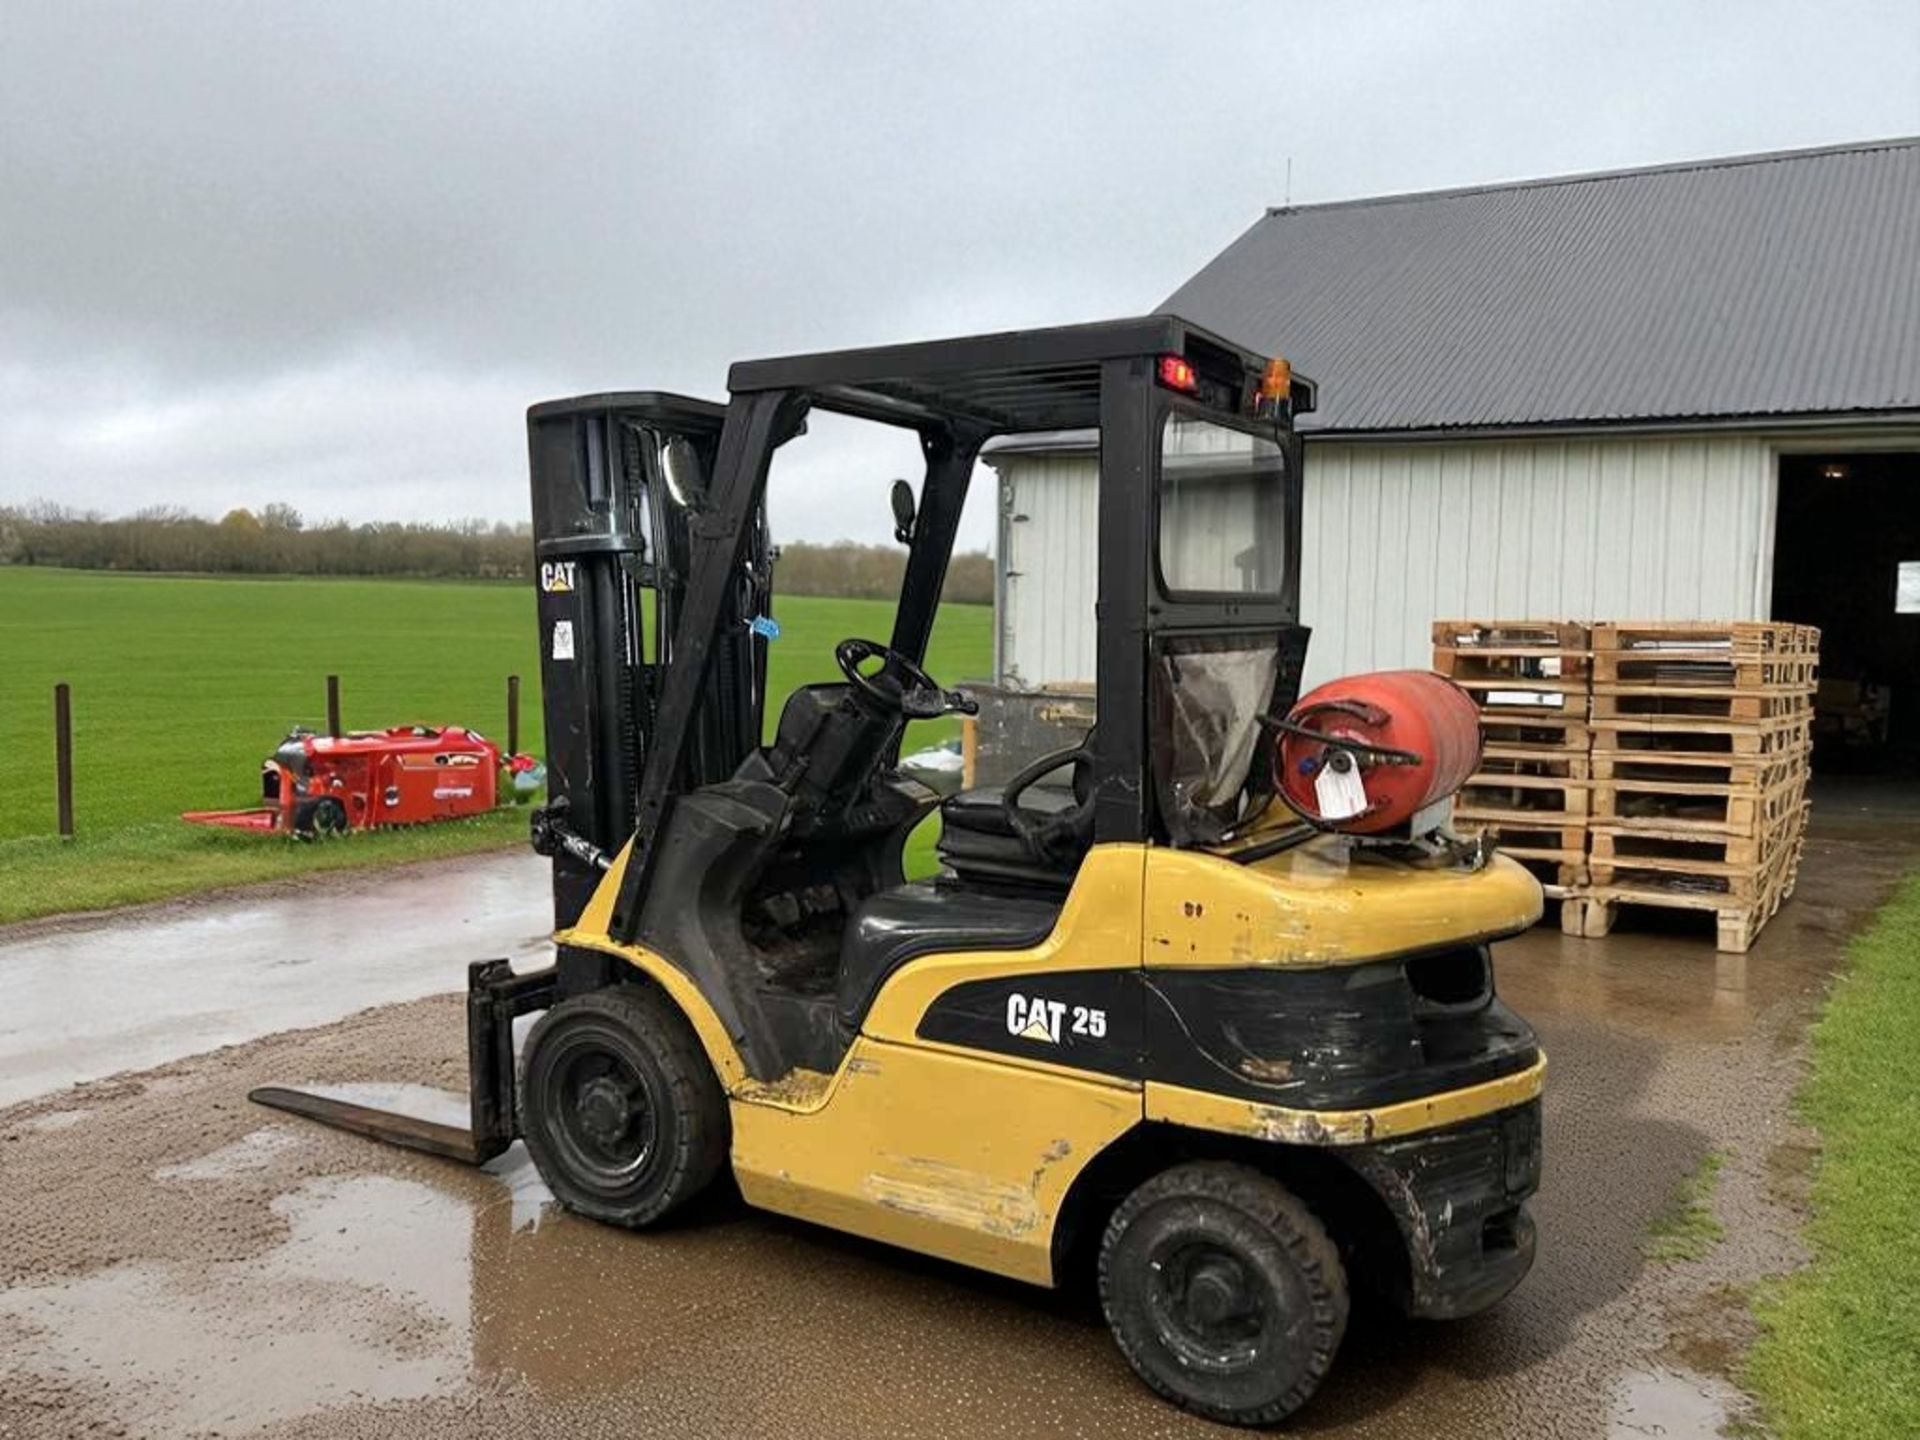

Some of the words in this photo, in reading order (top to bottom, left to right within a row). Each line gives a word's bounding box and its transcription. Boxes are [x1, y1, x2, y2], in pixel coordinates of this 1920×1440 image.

[541, 562, 575, 592] CAT
[1006, 993, 1067, 1044] CAT
[1072, 1006, 1107, 1038] 25
